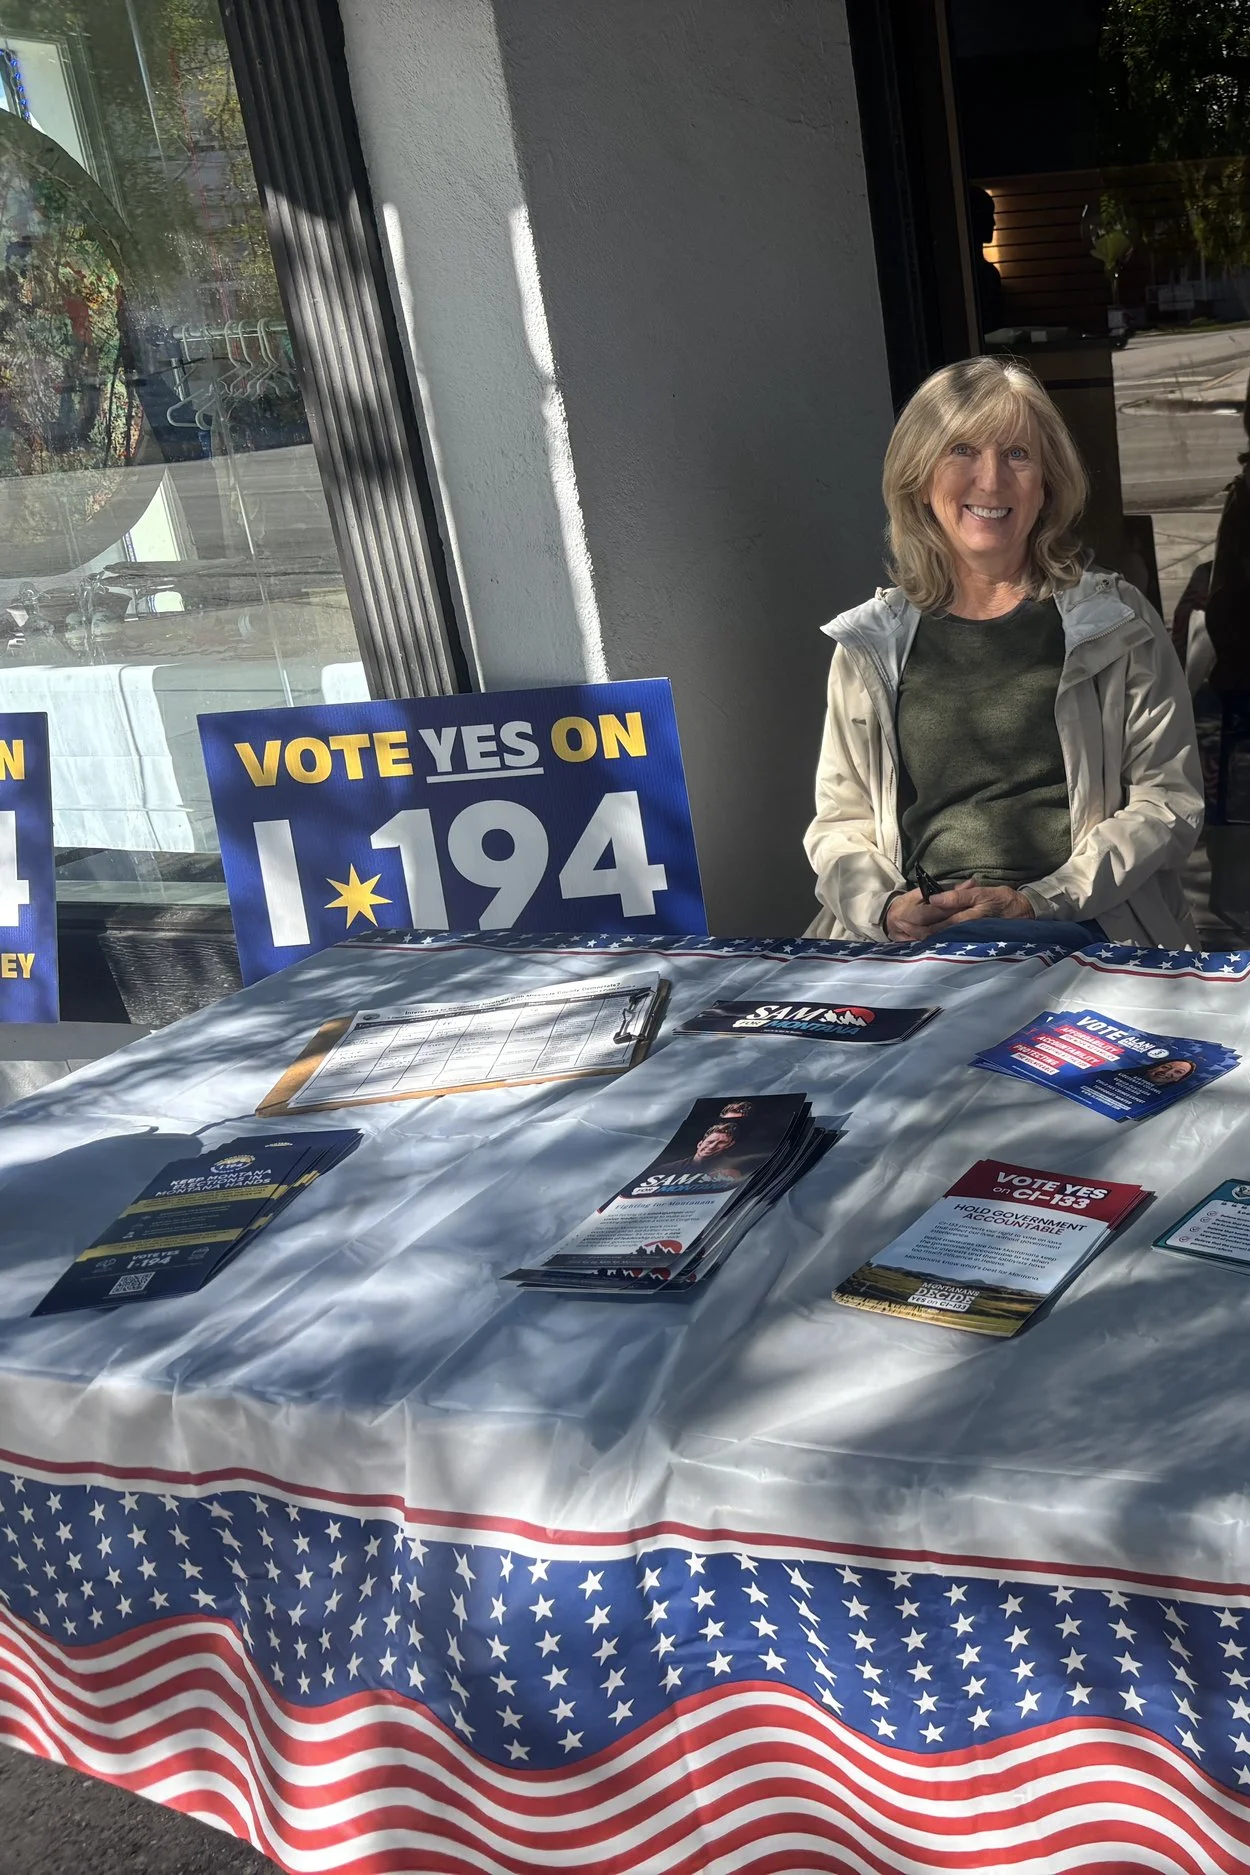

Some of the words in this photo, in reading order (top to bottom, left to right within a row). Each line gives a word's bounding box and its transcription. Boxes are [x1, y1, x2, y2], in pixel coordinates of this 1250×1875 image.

[234, 730, 414, 788] VOTE
[419, 720, 542, 775] YES
[550, 711, 648, 764] ON
[746, 1005, 828, 1021] SAM
[764, 1020, 861, 1035] MONTANA
[1076, 1016, 1128, 1041] VOTE
[1060, 1027, 1118, 1052] AFFORDABILITY
[1013, 1044, 1060, 1066] PROTECTING
[1037, 1036, 1100, 1064] ACCOUNTABILITY
[170, 1177, 205, 1186] KEEP
[207, 1169, 272, 1181] MONTANA
[173, 1176, 246, 1190] ELECTIONS
[640, 1173, 704, 1187] SAM
[996, 1172, 1061, 1191] VOTE
[1064, 1183, 1108, 1200] YES
[155, 1184, 221, 1197] MONTANA
[225, 1178, 271, 1188] HANDS
[615, 1202, 651, 1210] Fighting
[992, 1186, 1011, 1195] on
[1012, 1188, 1091, 1210] CI-133
[953, 1204, 991, 1215] HOLD
[992, 1207, 1088, 1231] GOVERNMENT
[962, 1213, 1066, 1235] ACCOUNTABLE
[126, 1256, 172, 1269] I-194
[133, 1252, 160, 1260] VOTE
[914, 1288, 976, 1306] DECIDE
[921, 1282, 981, 1296] MONTANANS
[939, 1301, 969, 1311] CI-133
